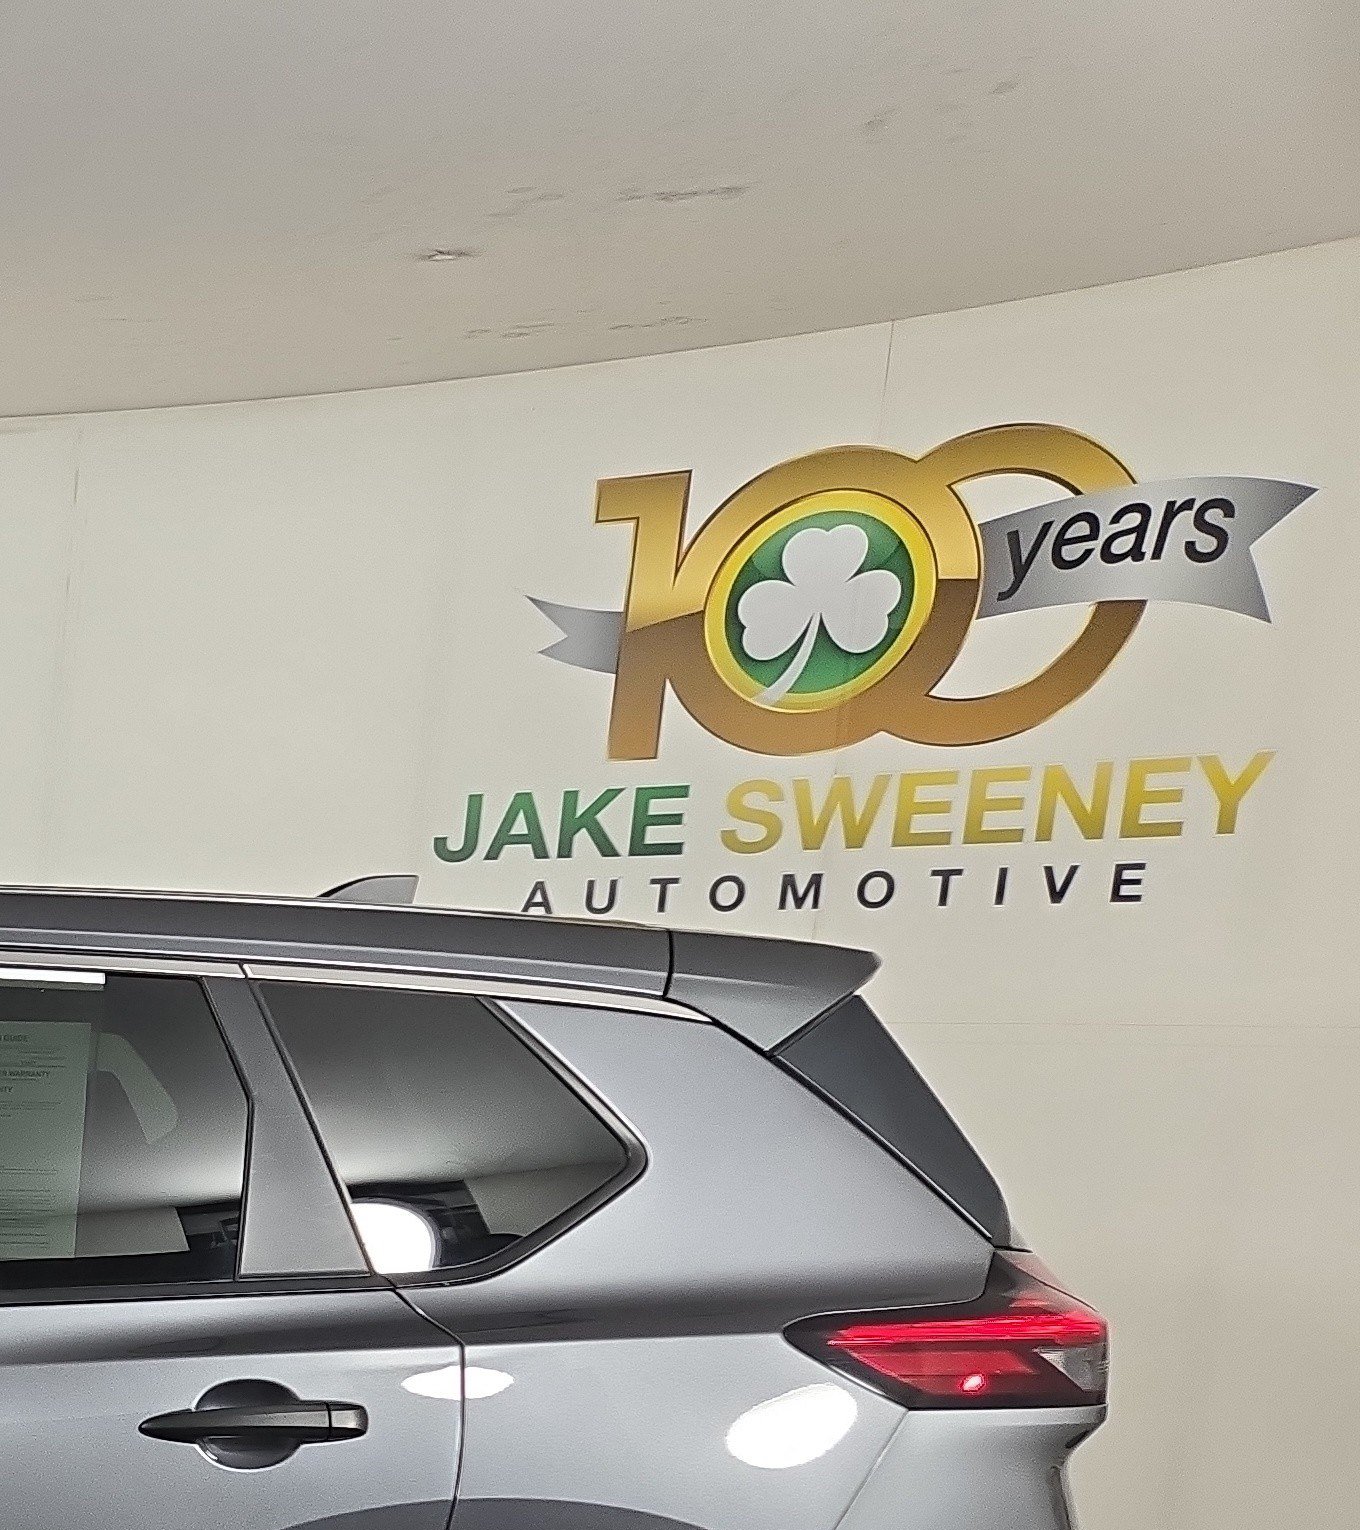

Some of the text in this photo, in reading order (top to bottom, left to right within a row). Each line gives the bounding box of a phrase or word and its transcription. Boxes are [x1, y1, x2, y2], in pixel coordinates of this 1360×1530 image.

[594, 422, 1236, 762] 100 years
[433, 749, 1276, 863] JAKE SWEENEY
[521, 862, 1147, 915] AUTOMOTIVE
